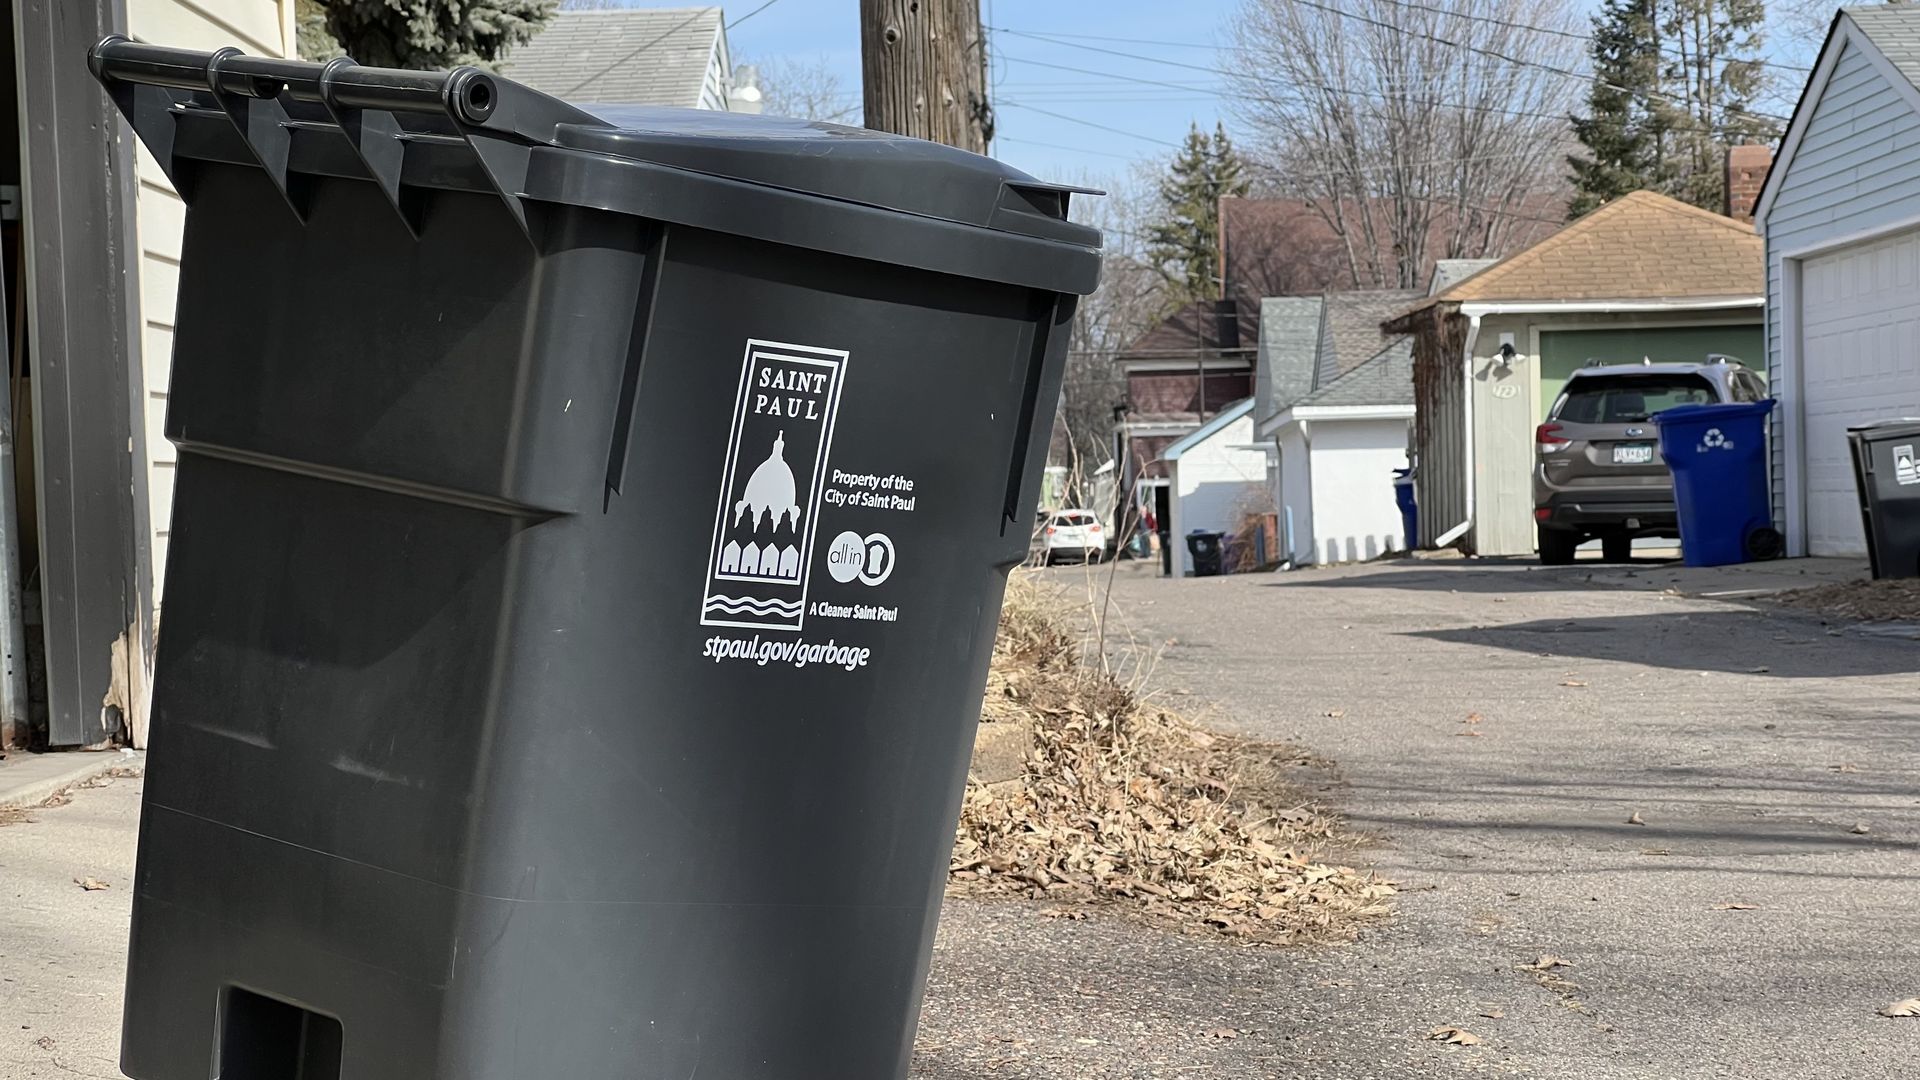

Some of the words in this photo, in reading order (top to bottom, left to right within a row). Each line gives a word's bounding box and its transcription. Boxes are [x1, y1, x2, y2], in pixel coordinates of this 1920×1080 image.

[759, 367, 827, 394] SAINT
[754, 394, 819, 420] PAUL
[832, 468, 880, 491] Property
[880, 474, 895, 489] of
[894, 475, 914, 491] the
[824, 488, 847, 508] City
[847, 490, 862, 506] of
[860, 491, 890, 509] Saint
[890, 494, 916, 512] Paul
[829, 543, 848, 564] all
[849, 547, 862, 565] in
[809, 601, 817, 616] A
[818, 601, 853, 619] Cleaner
[852, 604, 877, 621] Saint
[876, 606, 898, 622] Paul
[702, 634, 871, 672] stpaul.gov/garbage
